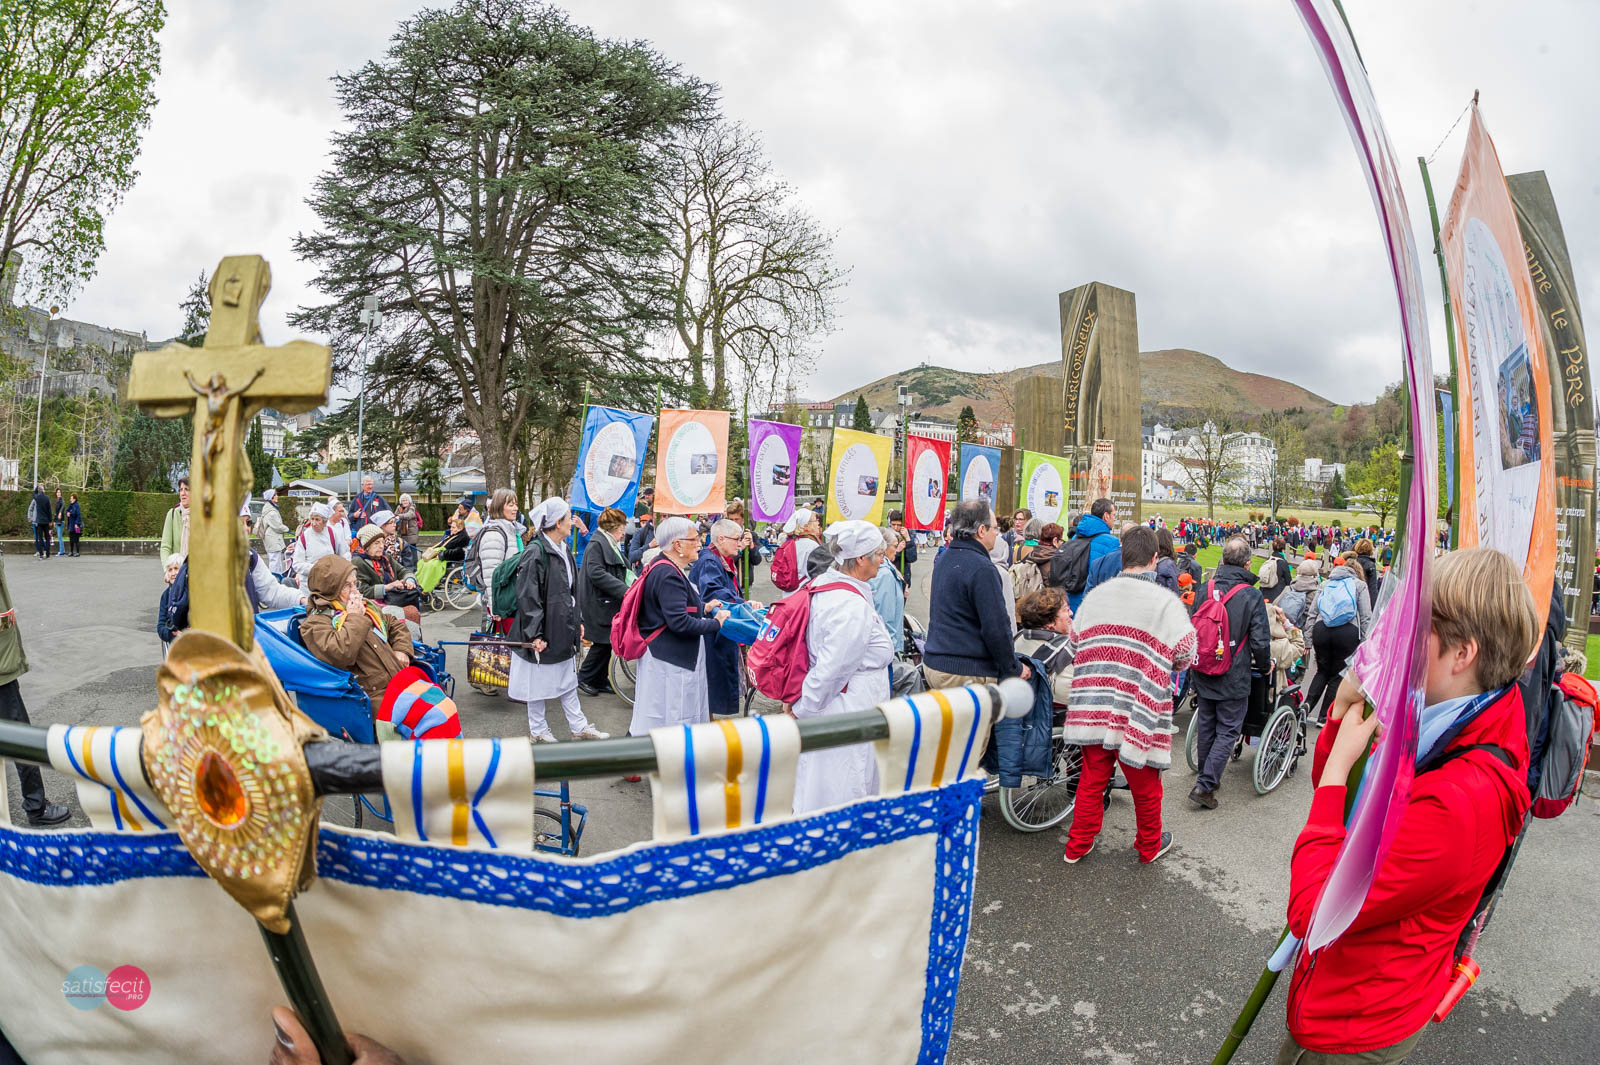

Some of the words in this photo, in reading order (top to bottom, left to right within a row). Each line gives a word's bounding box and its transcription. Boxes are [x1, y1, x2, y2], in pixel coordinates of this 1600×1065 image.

[1524, 240, 1552, 295] mme
[1550, 307, 1568, 331] le
[1467, 264, 1481, 438] PRISONNIERS
[755, 441, 770, 469] OFFENSES
[1476, 456, 1485, 498] LES
[837, 490, 852, 517] CONSOLER
